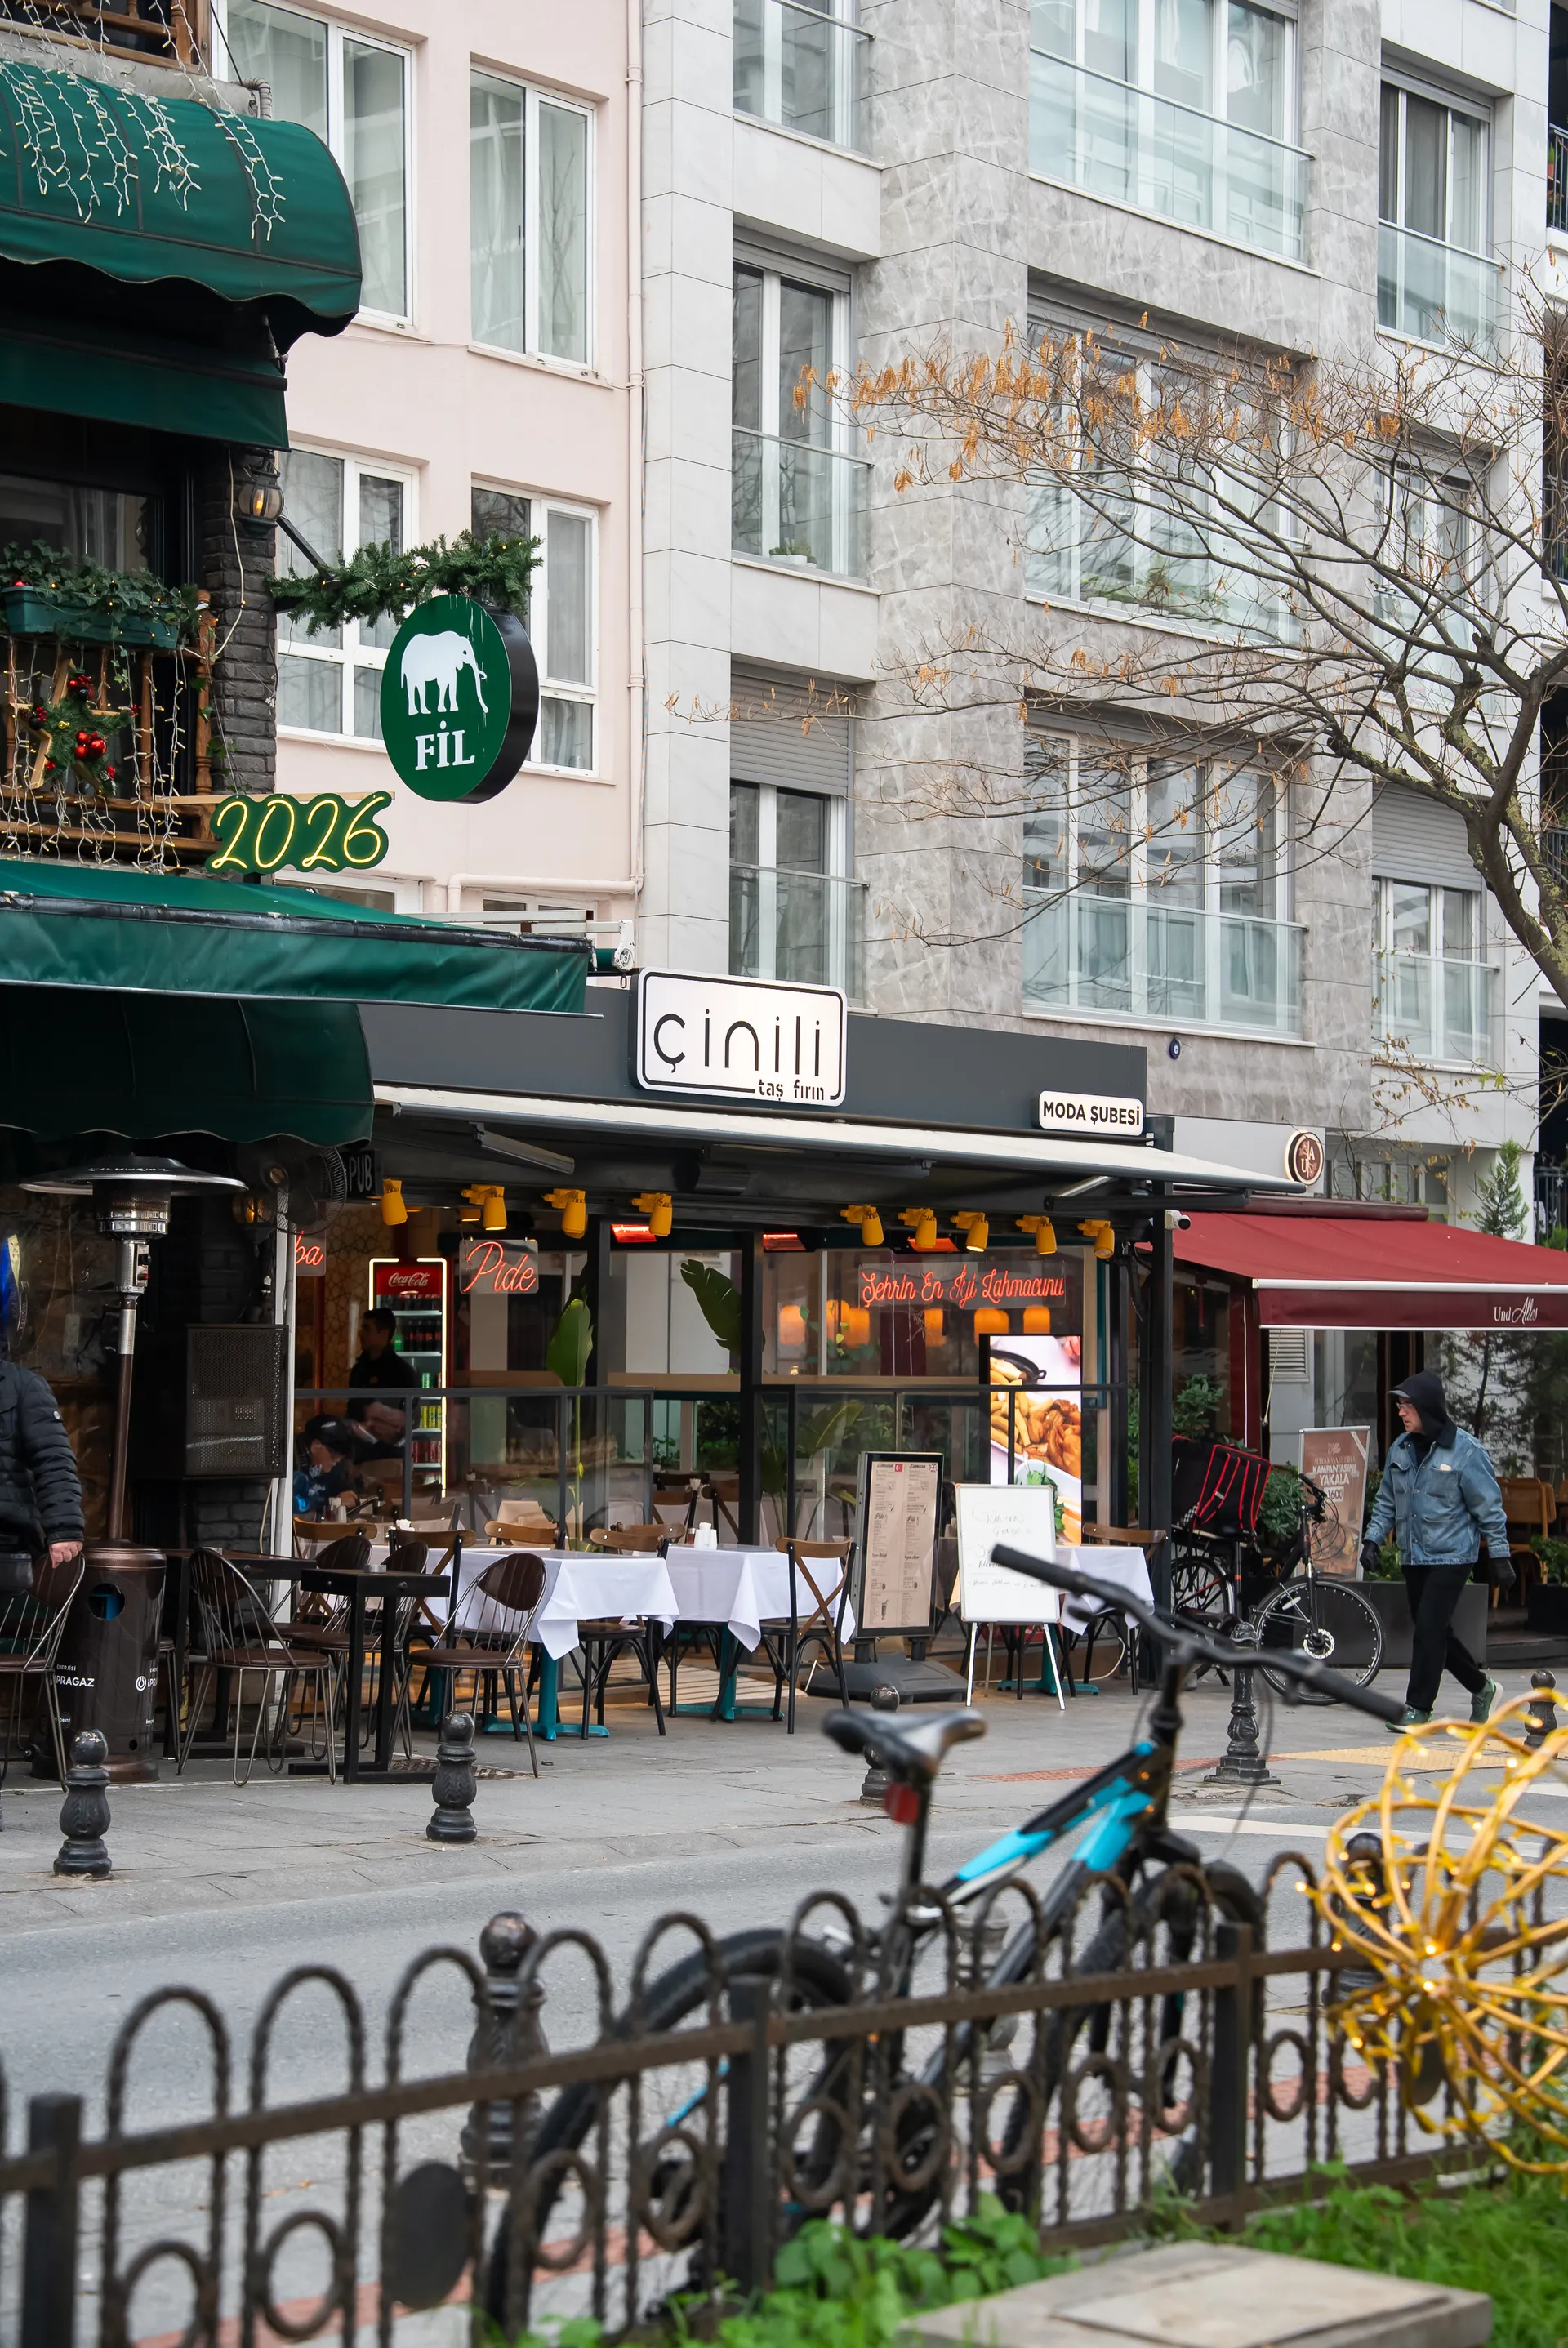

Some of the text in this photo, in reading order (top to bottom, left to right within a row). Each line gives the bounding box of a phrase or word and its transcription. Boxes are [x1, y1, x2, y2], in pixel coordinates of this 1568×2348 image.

[414, 720, 475, 771] FİL
[211, 795, 385, 870] 2026
[759, 1079, 824, 1102] taş fırın
[1043, 1101, 1140, 1125] MODA ŞUBESİ
[349, 1155, 372, 1192] PUB
[462, 1241, 537, 1292] Pide
[862, 1272, 916, 1308] Şehrin
[920, 1271, 944, 1301] En
[982, 1268, 1064, 1303] Lahmacunu
[1494, 1306, 1512, 1321] Und
[1320, 1473, 1350, 1486] YAKALA
